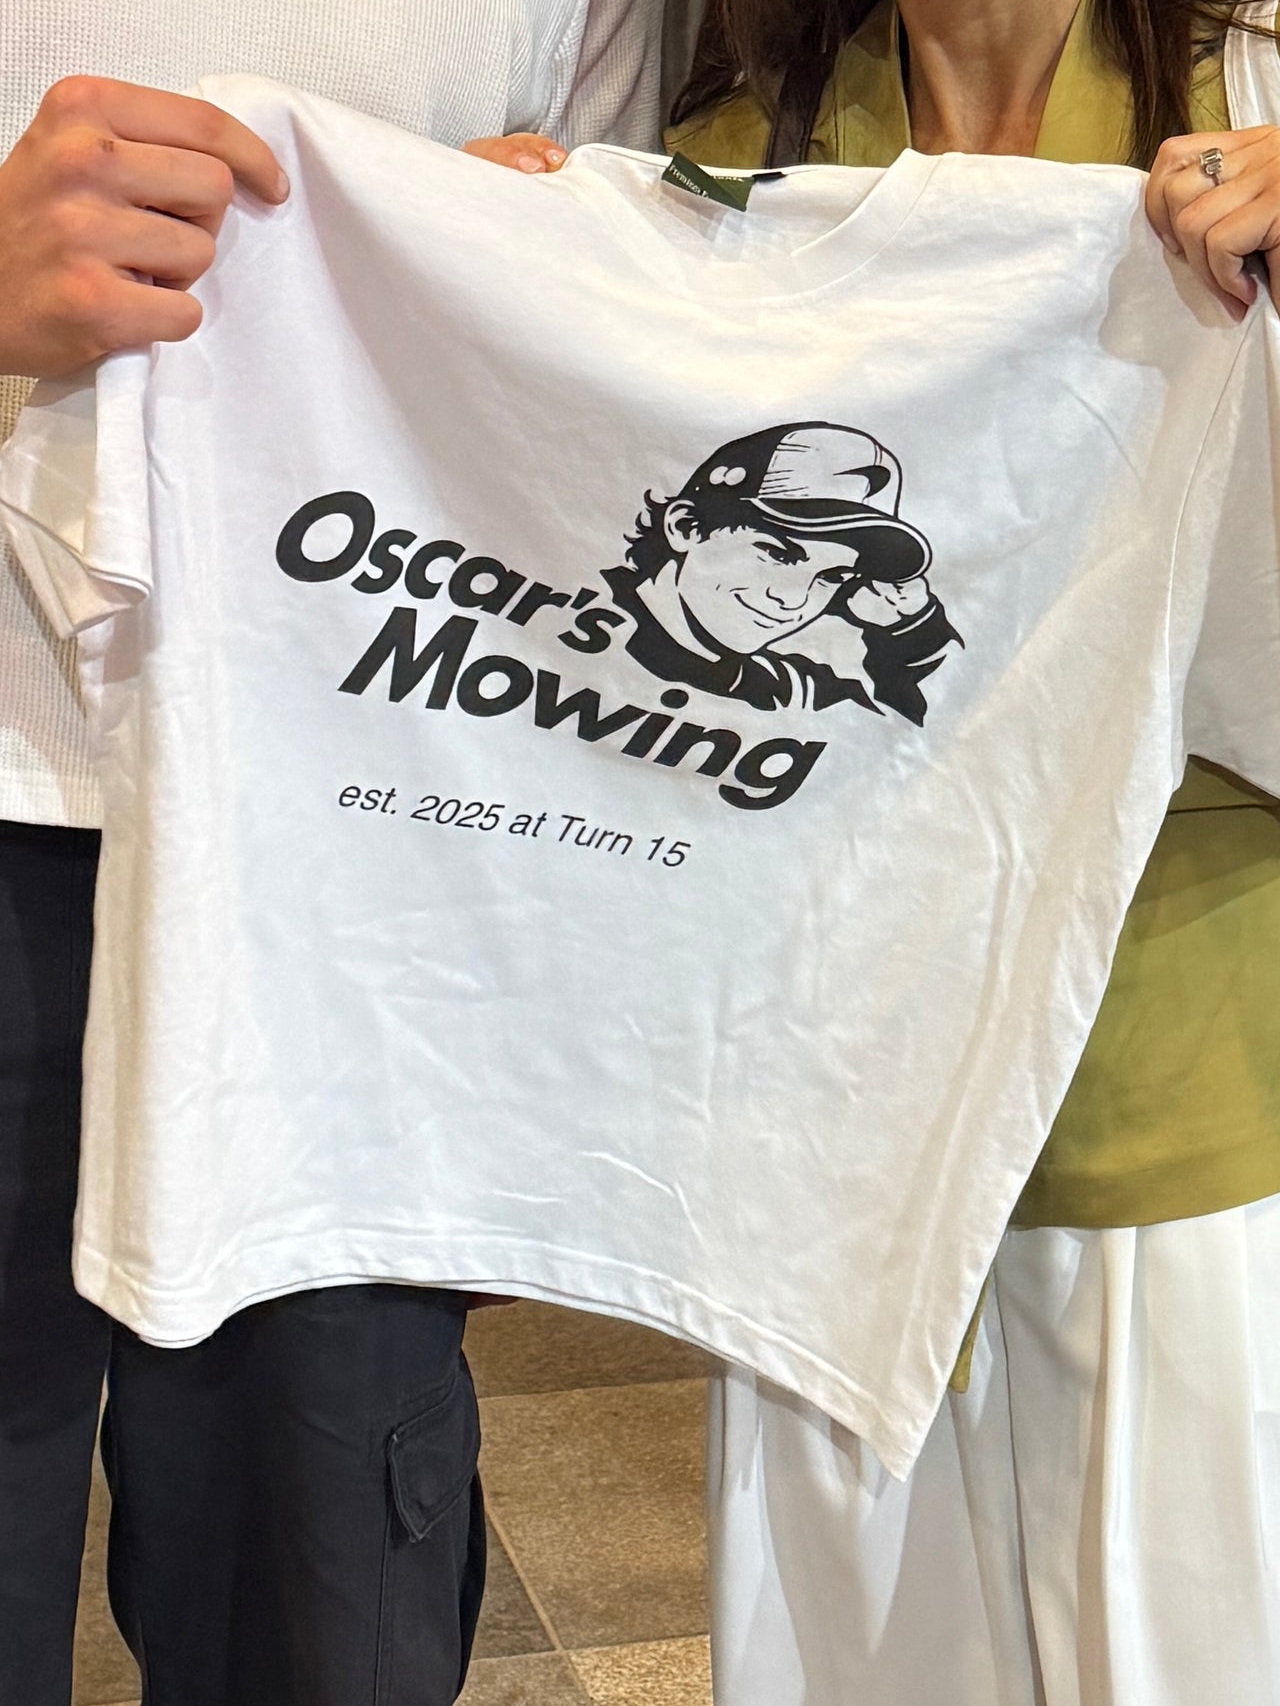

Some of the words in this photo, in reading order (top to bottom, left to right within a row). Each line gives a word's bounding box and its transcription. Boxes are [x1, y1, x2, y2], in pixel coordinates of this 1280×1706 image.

[275, 490, 627, 655] Oscar's
[337, 606, 828, 811] Mowing
[338, 785, 399, 815] est.
[410, 795, 506, 831] 2025
[508, 812, 547, 838] at
[558, 814, 633, 855] Turn
[647, 836, 691, 867] 15
